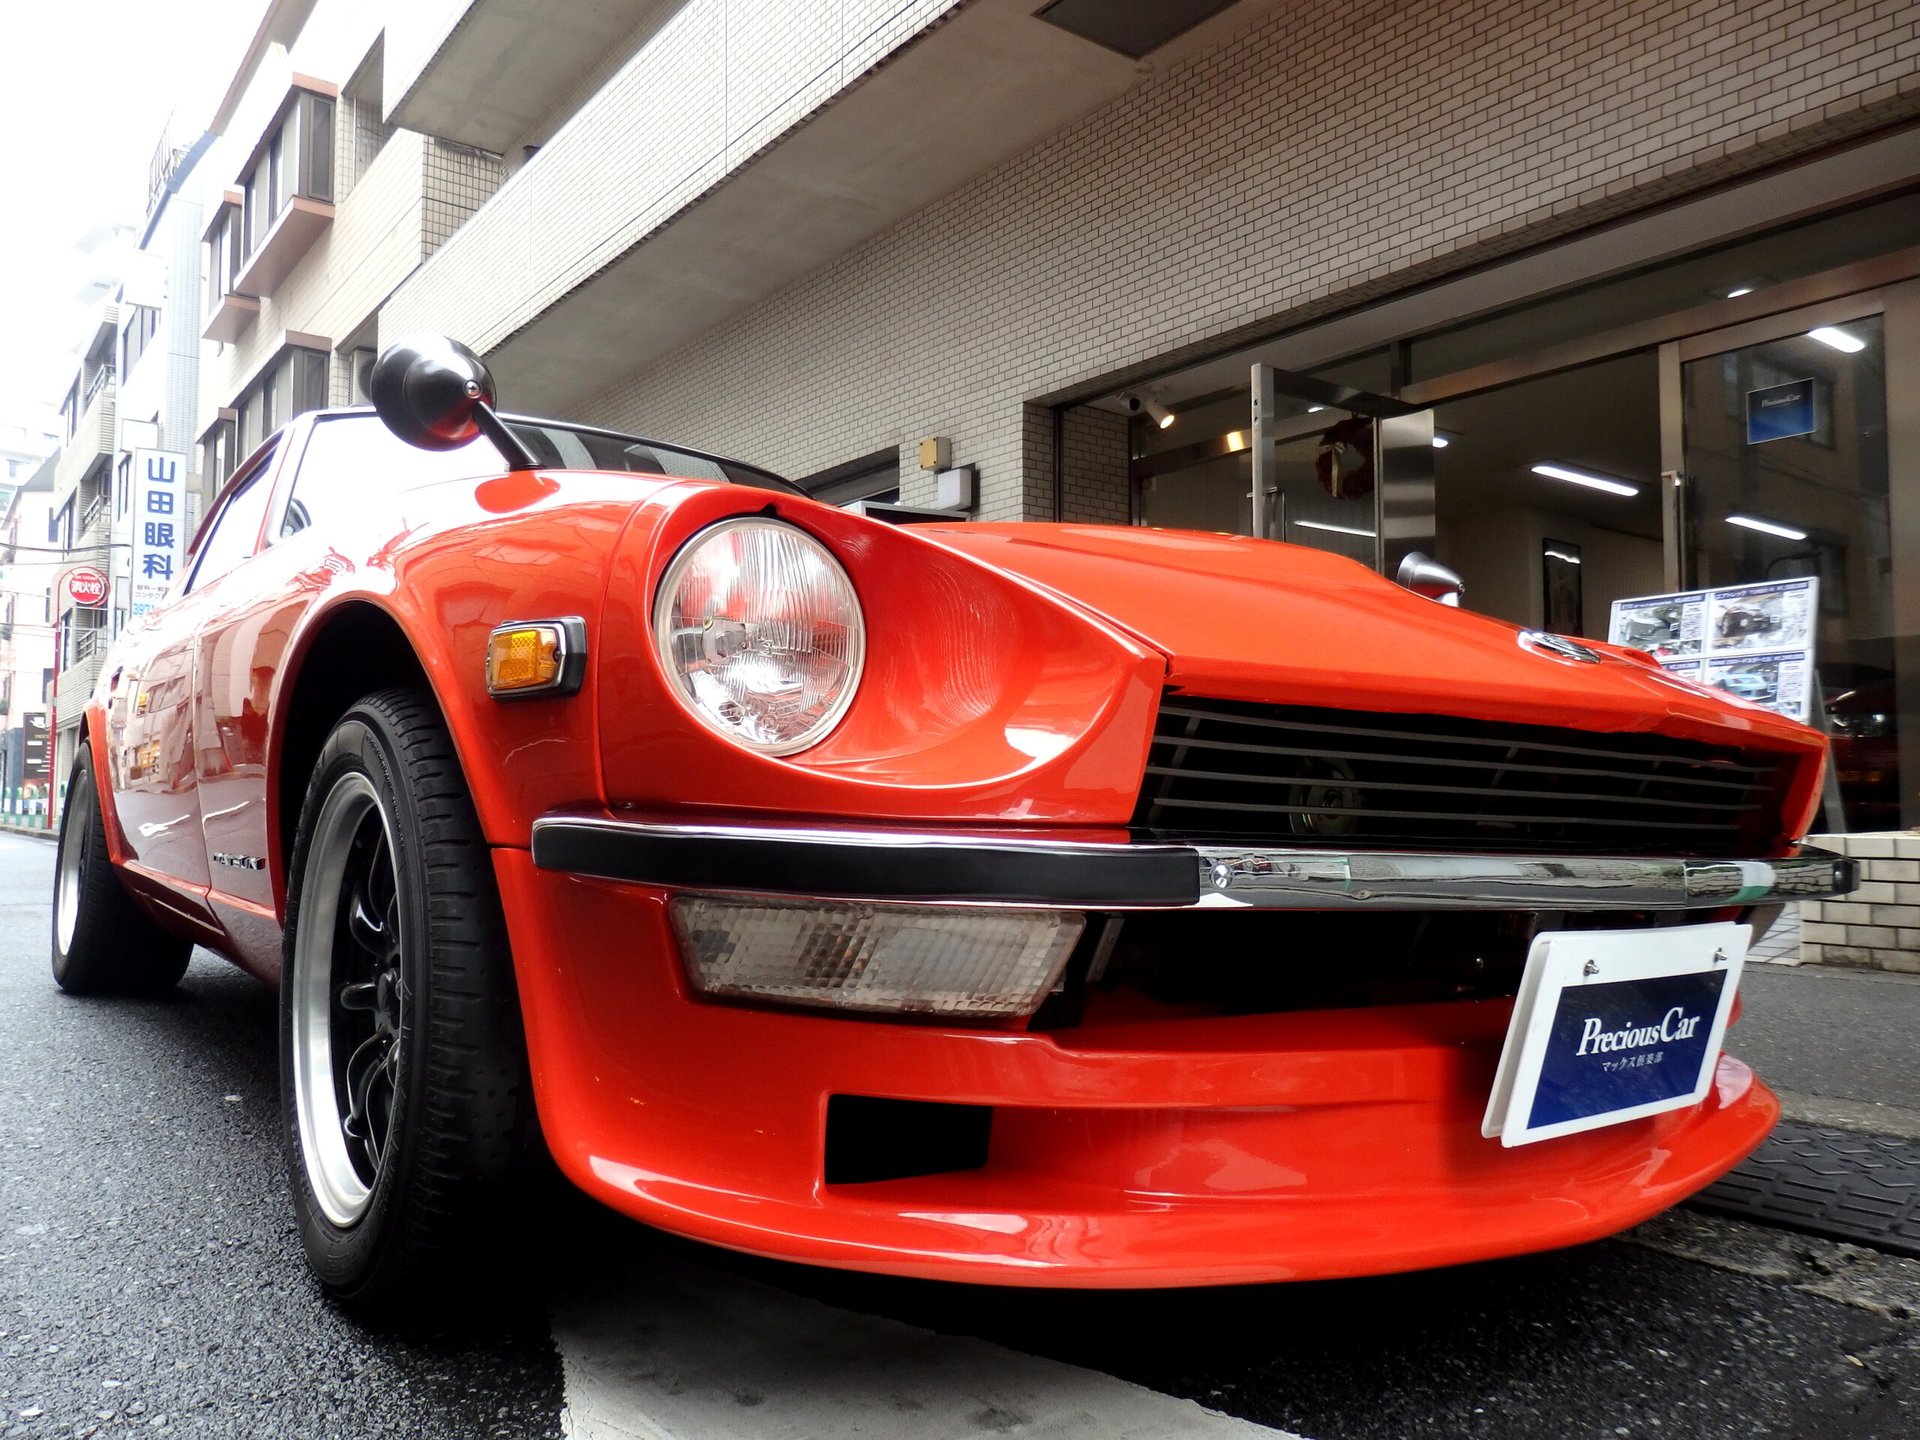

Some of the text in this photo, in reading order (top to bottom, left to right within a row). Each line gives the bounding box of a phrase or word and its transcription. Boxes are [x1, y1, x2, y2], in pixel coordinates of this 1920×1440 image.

[143, 457, 176, 580] 山田眼科
[71, 581, 101, 594] 消火栓
[1576, 1007, 1700, 1056] PreciousCar
